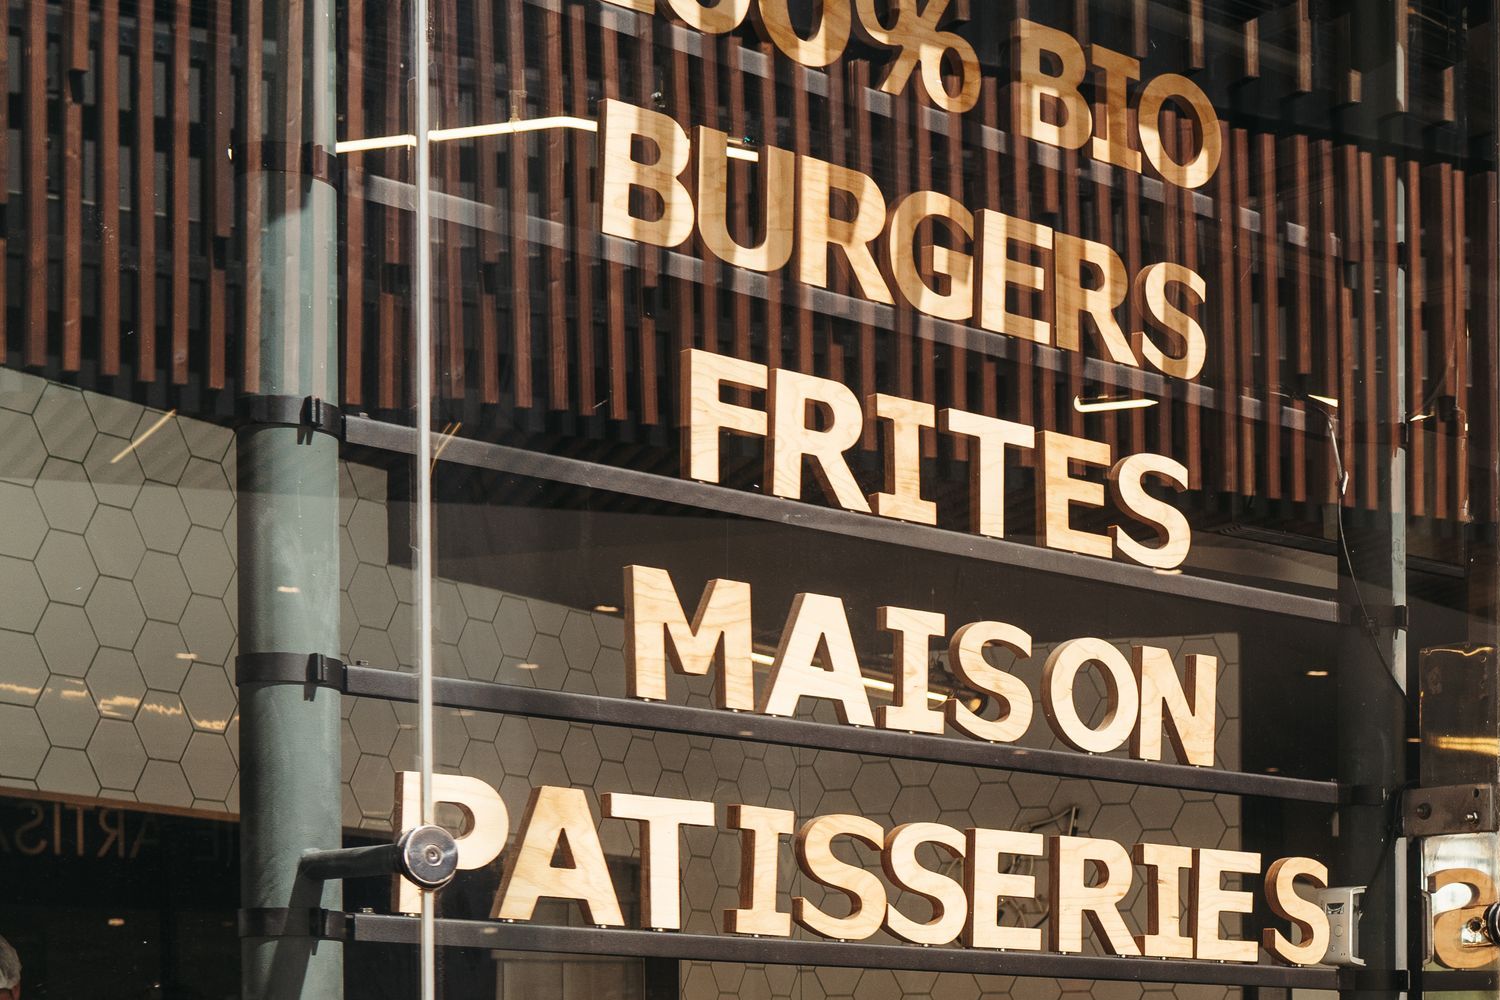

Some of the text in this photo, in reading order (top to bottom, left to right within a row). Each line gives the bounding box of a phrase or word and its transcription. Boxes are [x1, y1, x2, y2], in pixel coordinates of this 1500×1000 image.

[1014, 17, 1222, 189] BIO
[599, 97, 1207, 380] BURGERS
[680, 348, 1192, 571] FRITES
[623, 564, 1217, 767] MAISON
[395, 770, 1332, 967] PATISSERIES
